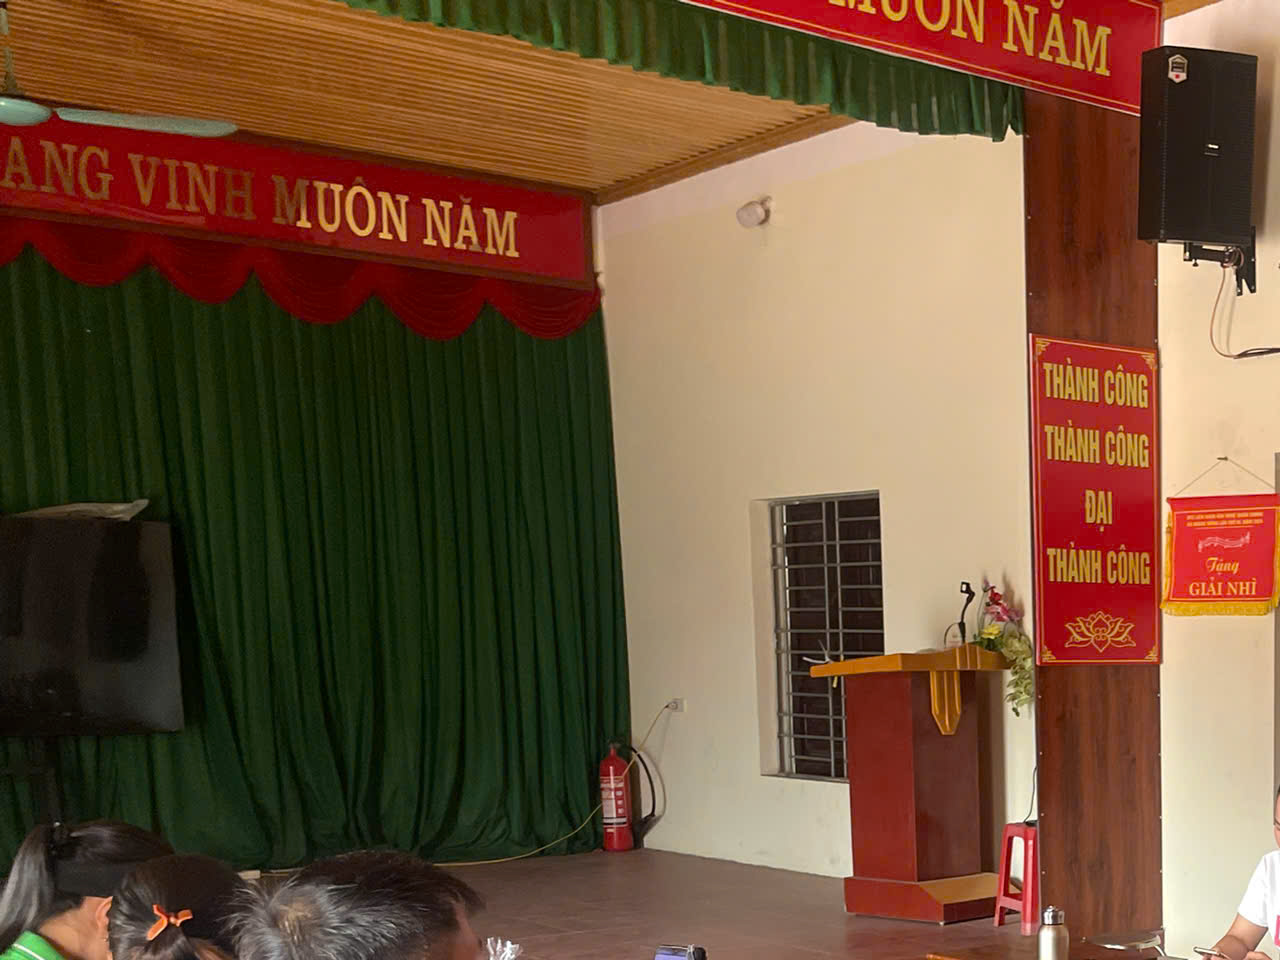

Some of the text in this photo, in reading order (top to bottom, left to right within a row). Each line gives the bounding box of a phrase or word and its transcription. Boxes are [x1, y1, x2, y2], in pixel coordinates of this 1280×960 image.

[1002, 0, 1112, 77] NĂM
[0, 135, 521, 258] ANG VINH MUÔN NĂM
[1043, 357, 1149, 409] THÀNH CÔNG
[1044, 420, 1150, 468] THÀNH CÔNG
[1084, 488, 1113, 533] ĐẠI
[1046, 541, 1152, 585] THÀNH CÔNG
[1188, 576, 1257, 596] GIẢI NHÌ
[1205, 556, 1240, 576] Tặng
